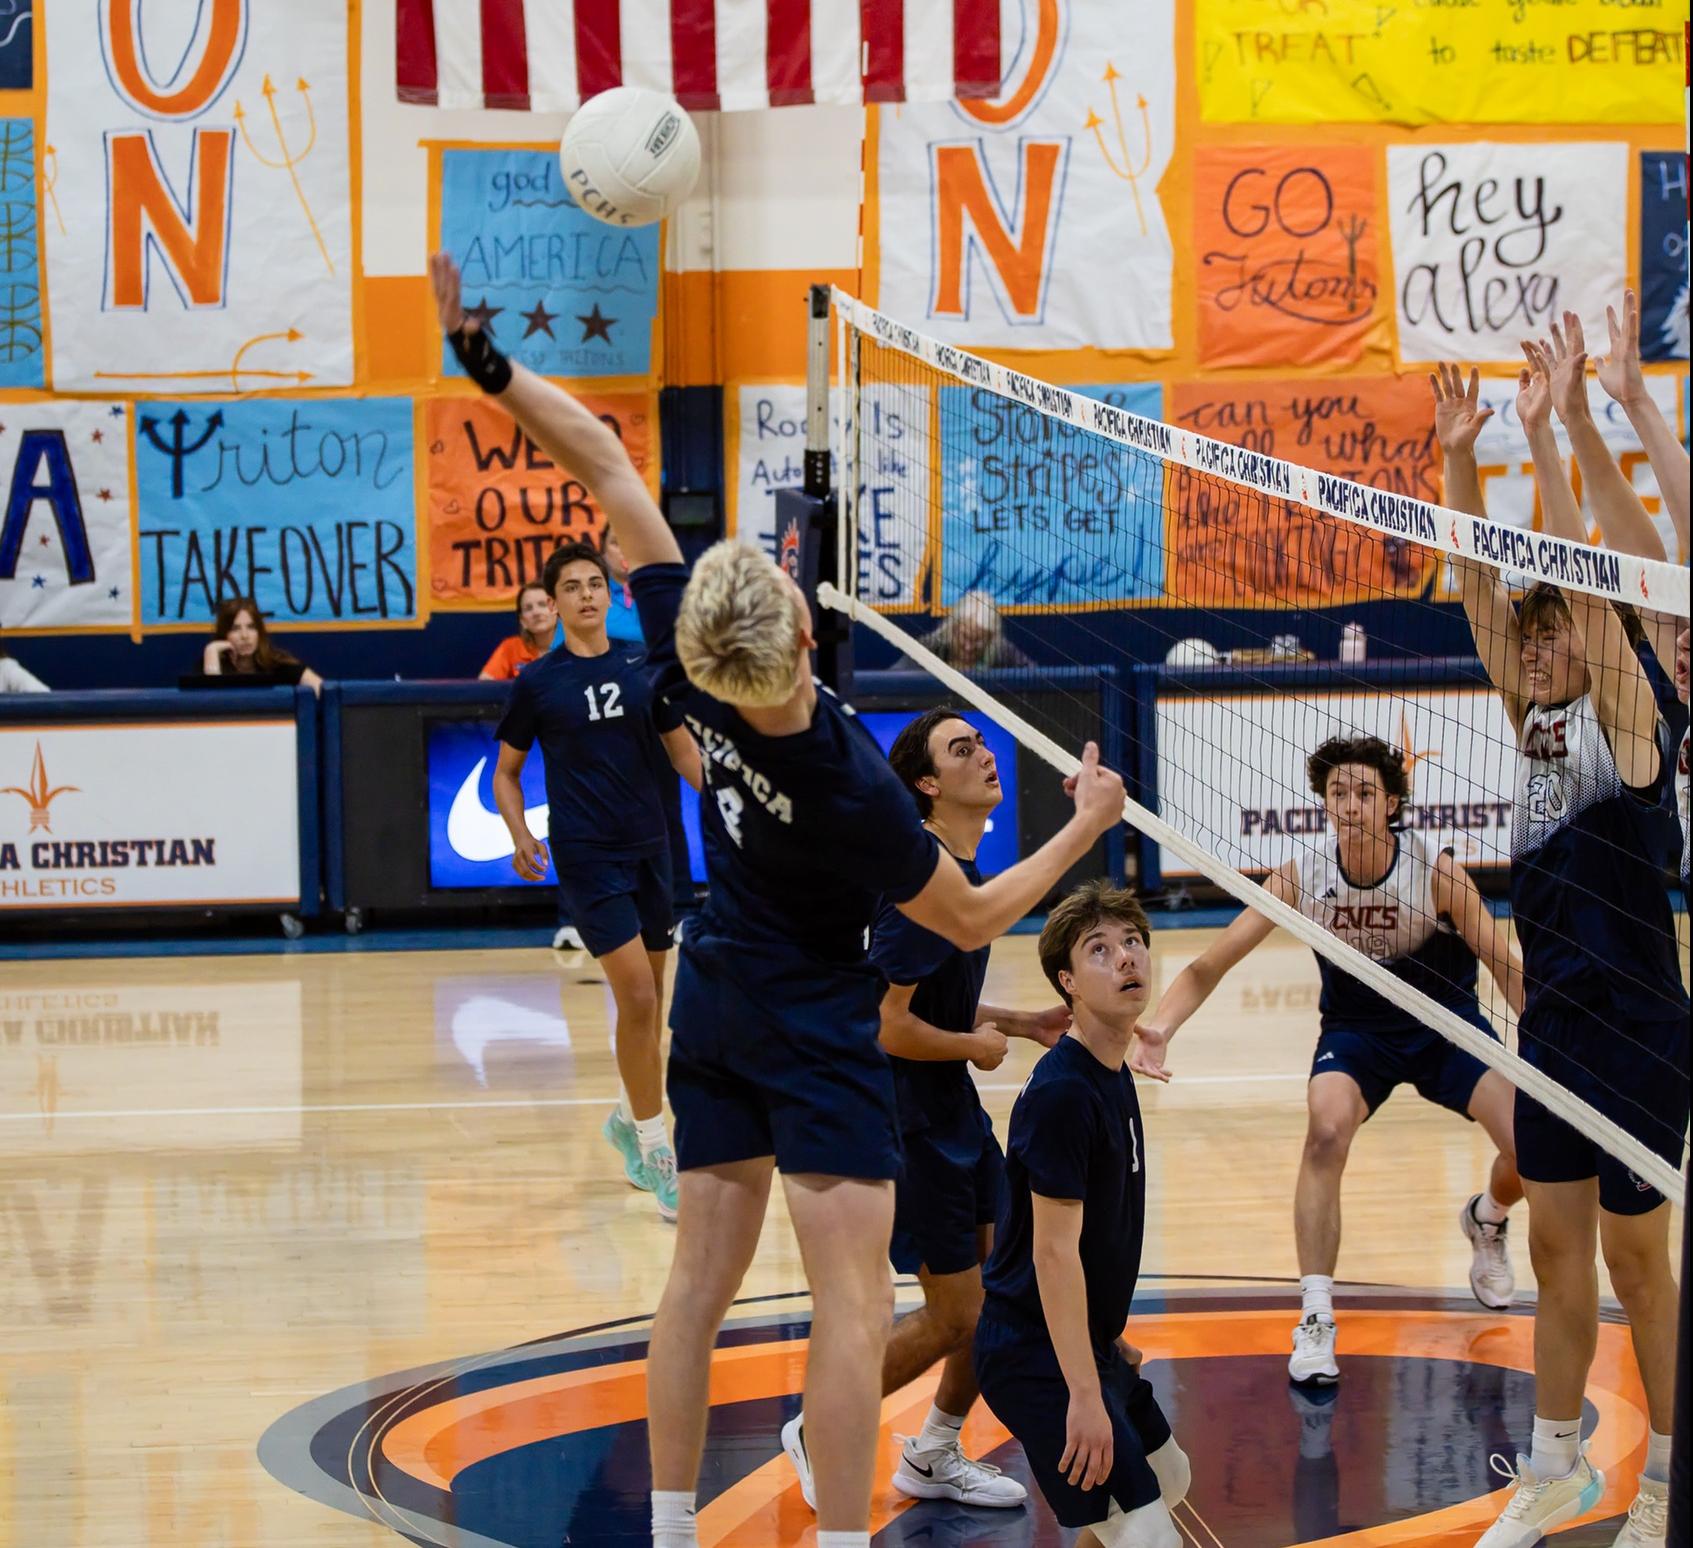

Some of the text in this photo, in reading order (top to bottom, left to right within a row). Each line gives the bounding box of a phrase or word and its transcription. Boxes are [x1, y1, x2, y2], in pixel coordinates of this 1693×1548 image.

[1233, 32, 1366, 64] TREAT
[1428, 29, 1684, 65] to taste DEFEAT
[489, 161, 551, 210] god
[1222, 168, 1333, 238] GO
[1407, 152, 1562, 267] hey
[460, 232, 648, 283] AMERICA
[1402, 237, 1559, 333] alexa
[873, 400, 906, 440] Is
[1093, 403, 1173, 454] PACIFICA CHRISTIAN
[1178, 400, 1274, 429] can
[1285, 395, 1373, 446] you
[980, 450, 1125, 507] Stripes
[1195, 437, 1237, 479] PACIFICA
[1237, 452, 1291, 495] CHRISTIAN
[475, 480, 596, 533] OUR
[1064, 507, 1120, 538] GET
[1318, 475, 1369, 522] PACIFICA
[1370, 491, 1437, 542] CHRISTIAN
[140, 520, 415, 620] TAKEOVER
[1471, 519, 1622, 594] PACIFICA CHRISTIAN
[584, 682, 624, 722] 12
[1527, 771, 1568, 823] 20
[31, 838, 216, 870] CHRISTIAN
[1, 877, 117, 897] HLETICS
[1333, 905, 1399, 930] CVCS
